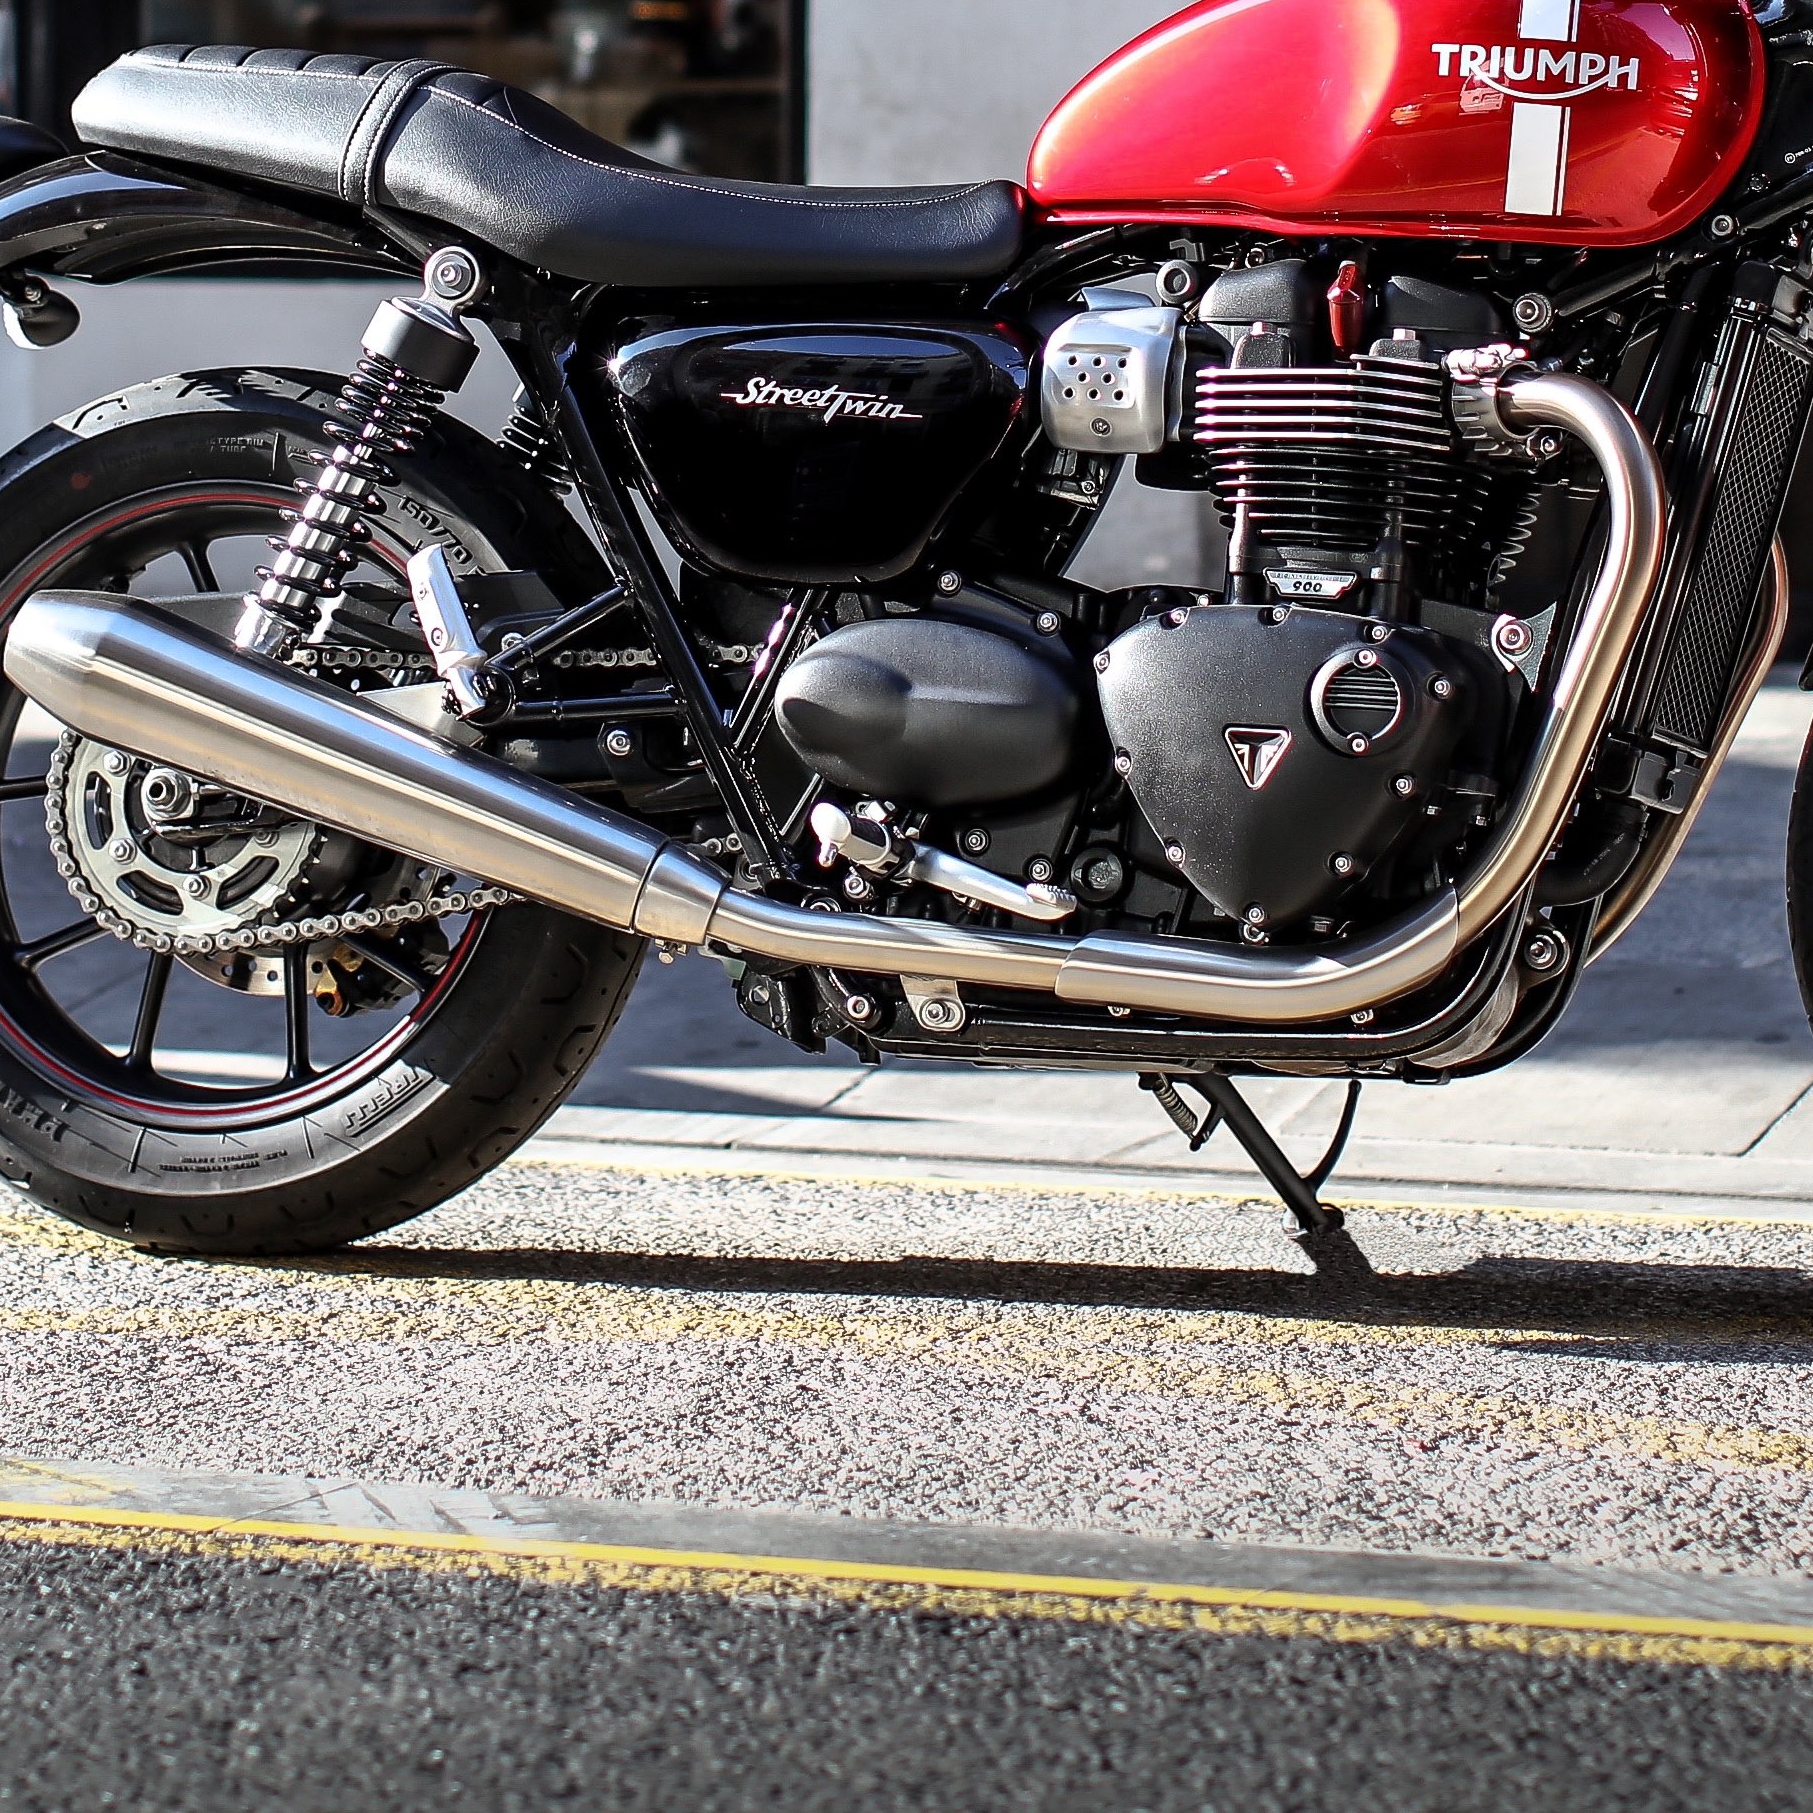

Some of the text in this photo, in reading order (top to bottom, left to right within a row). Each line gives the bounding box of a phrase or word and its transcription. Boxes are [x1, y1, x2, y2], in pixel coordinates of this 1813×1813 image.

[1431, 44, 1640, 98] TRIUMPH
[397, 494, 474, 564] 150/70
[1292, 580, 1323, 593] 900
